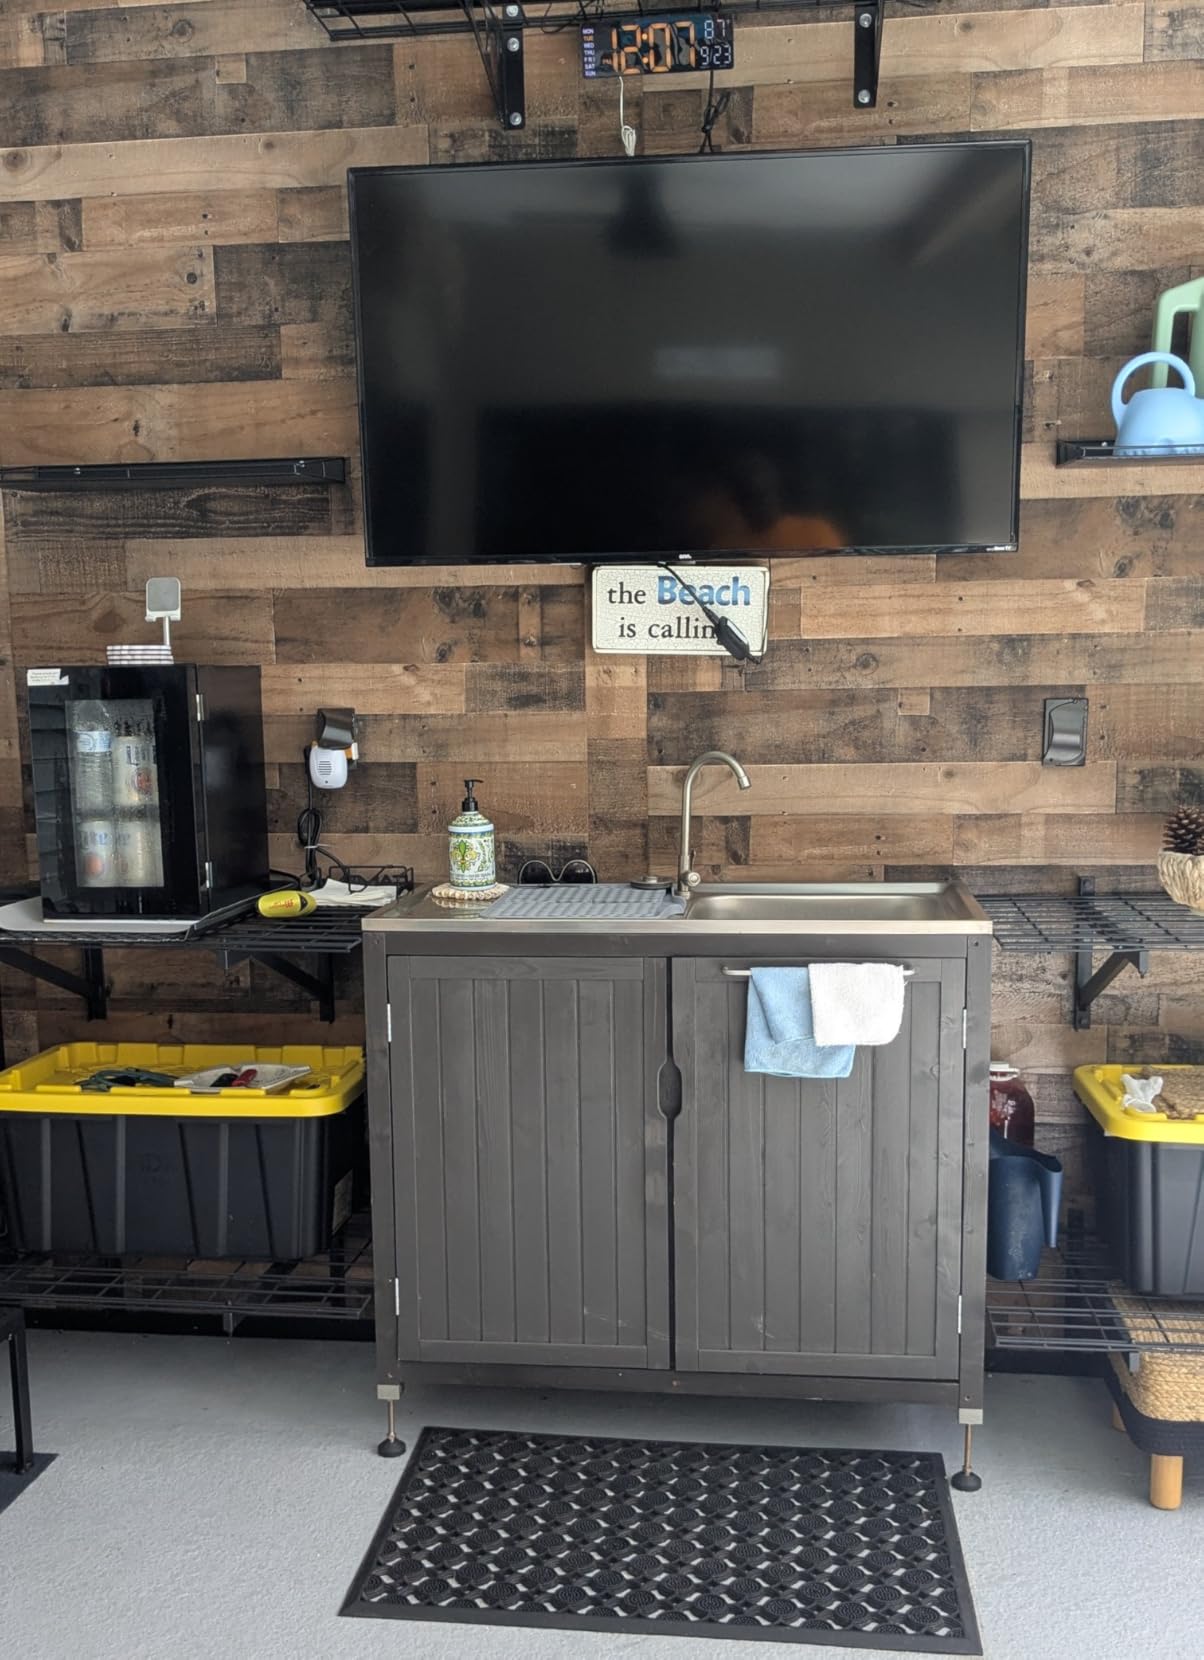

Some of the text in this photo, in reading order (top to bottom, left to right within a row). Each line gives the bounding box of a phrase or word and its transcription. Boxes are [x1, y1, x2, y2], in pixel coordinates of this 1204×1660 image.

[611, 20, 696, 75] 12:07
[700, 44, 732, 66] 9/23
[607, 575, 751, 606] the Beach
[618, 616, 722, 643] is callin
